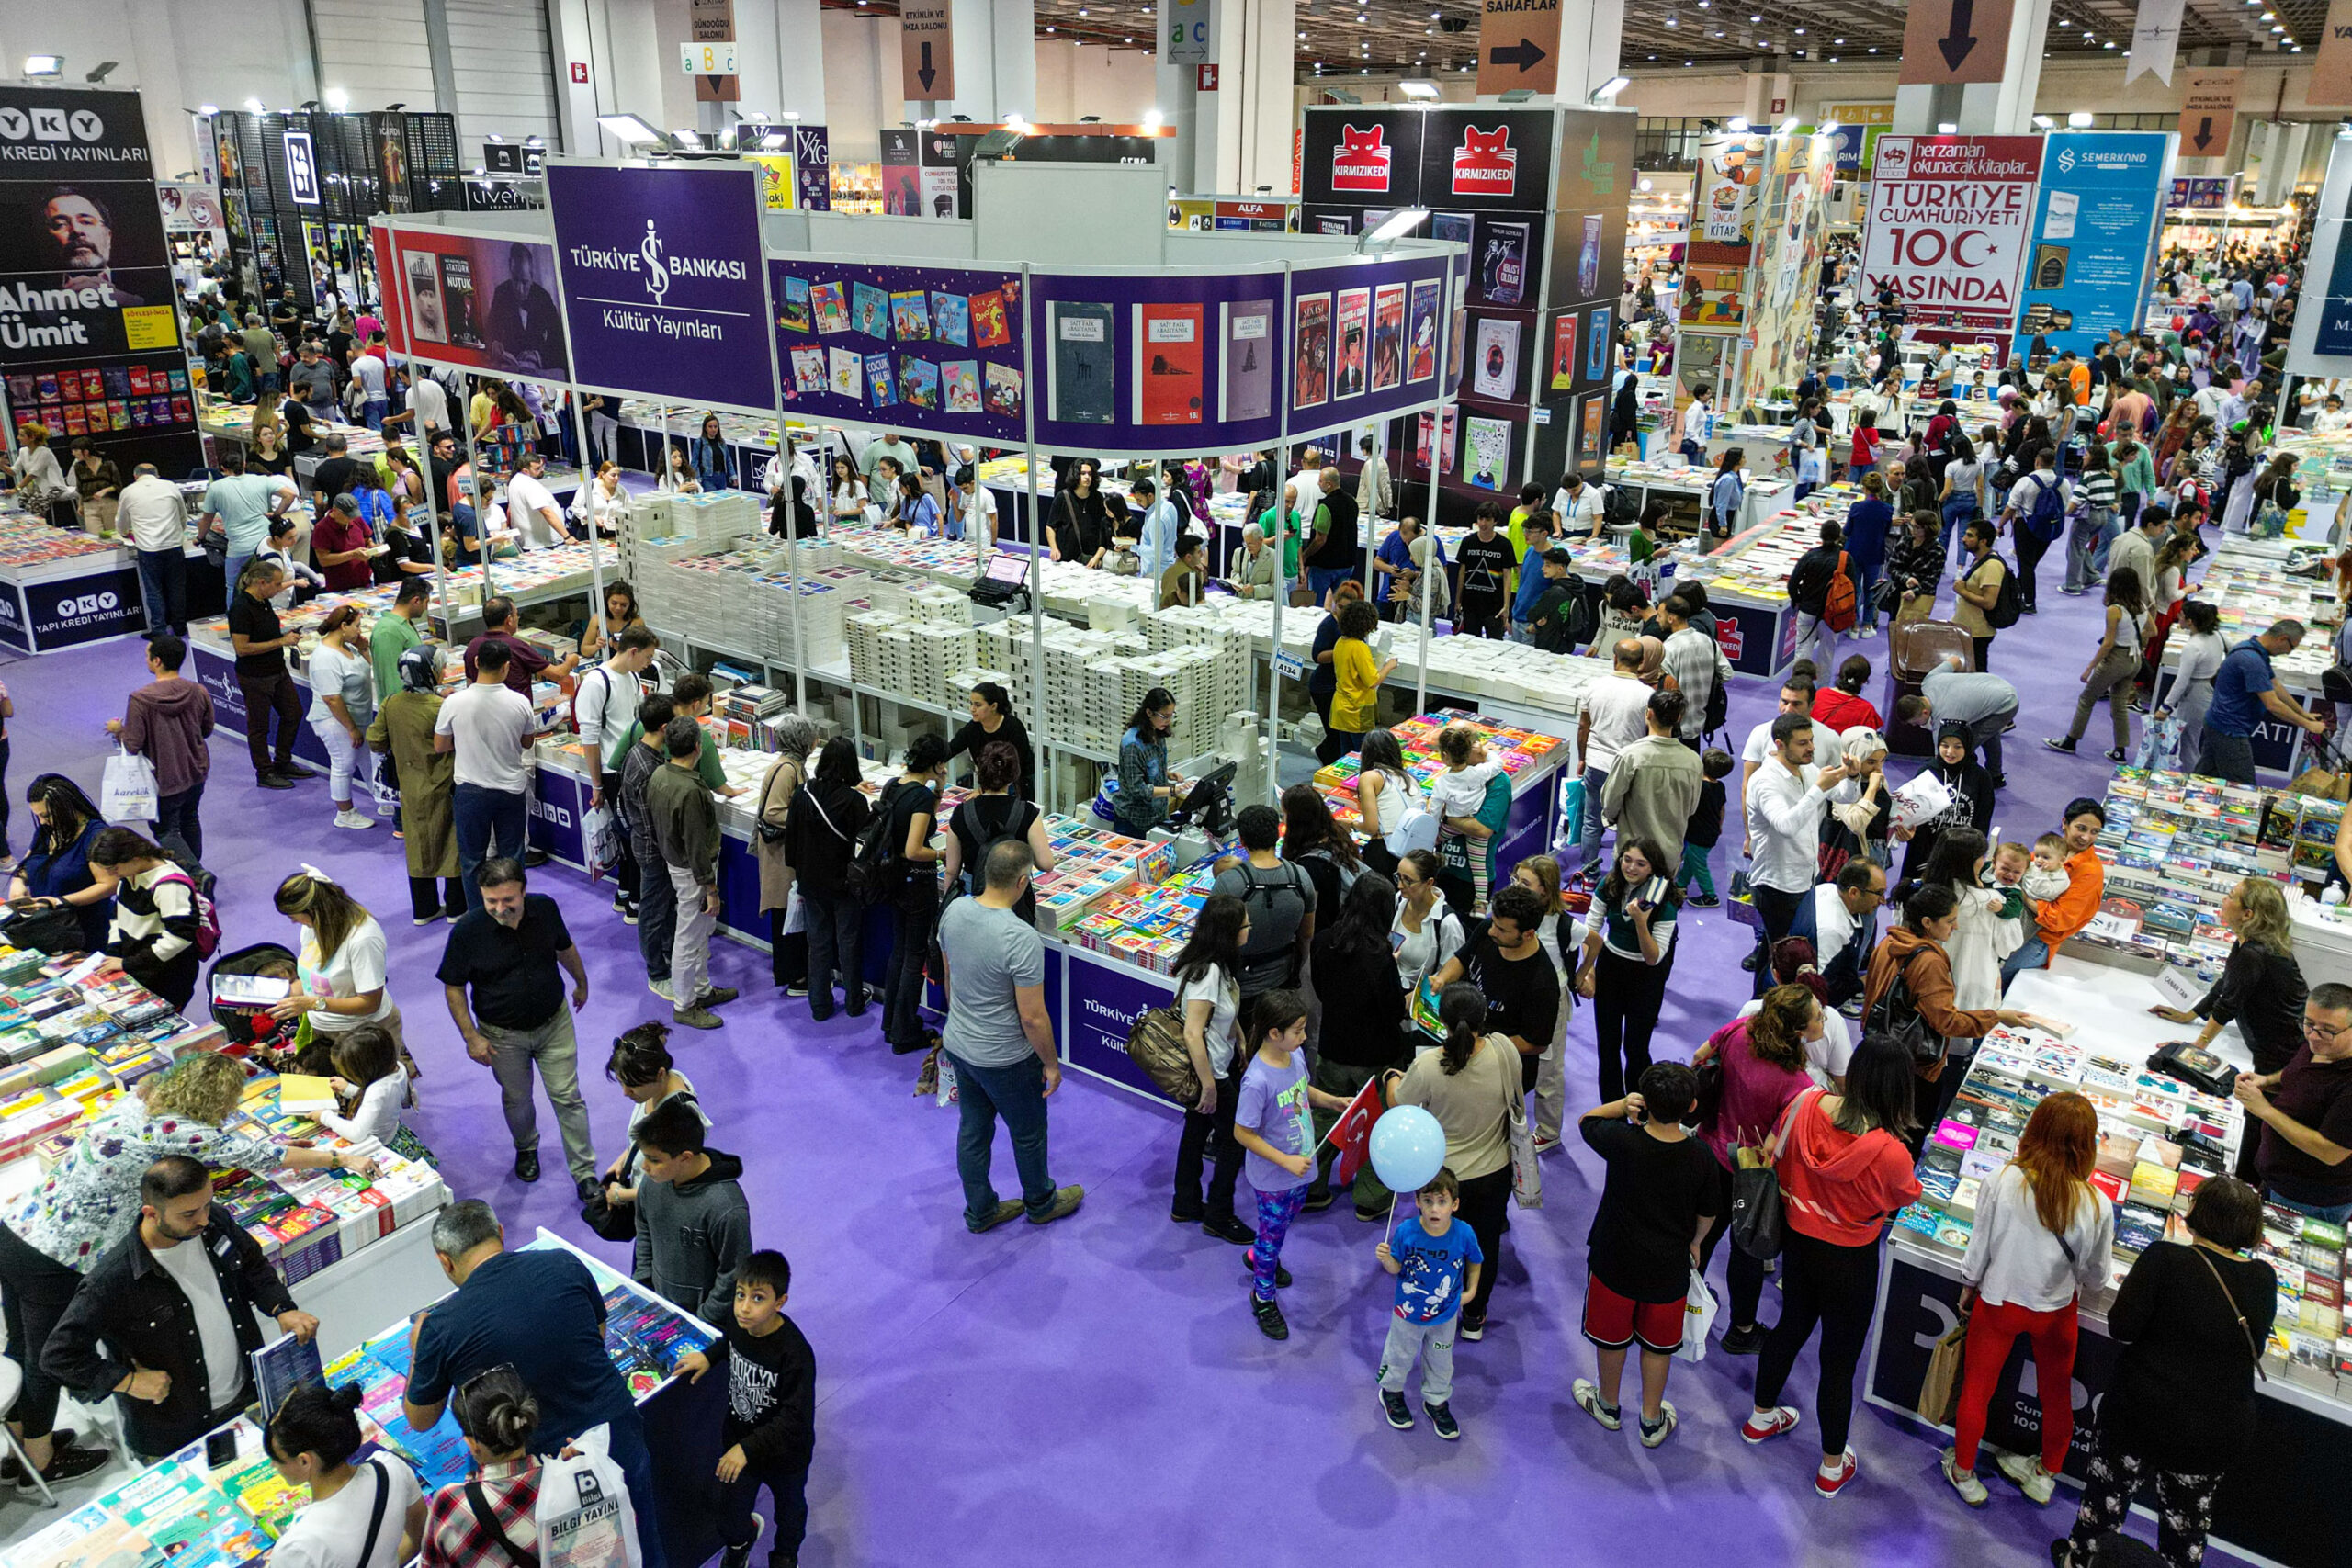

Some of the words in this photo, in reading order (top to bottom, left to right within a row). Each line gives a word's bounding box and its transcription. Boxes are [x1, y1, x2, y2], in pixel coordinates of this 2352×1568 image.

[906, 8, 934, 19] ETKİNLİK
[935, 10, 944, 18] VE
[694, 18, 729, 28] GÜNDOĞDU
[921, 22, 947, 31] SALONU
[699, 30, 724, 39] SALONU
[1171, 23, 1184, 43] a
[684, 58, 693, 71] a
[704, 47, 715, 71] B
[1, 143, 58, 161] KREDİ
[60, 146, 149, 162] YAYINLARI
[1334, 163, 1389, 177] KIRMIZIKEDİ
[1454, 166, 1514, 181] KIRMIZIKEDİ
[1882, 182, 2023, 209] TÜRKİYE
[1238, 204, 1264, 213] ALFA
[1712, 211, 1737, 223] SİNCAP
[1879, 208, 2020, 226] CUMHURİYETİ
[1710, 222, 1736, 238] KİTAP
[570, 244, 641, 272] TÜRKİYE
[669, 256, 747, 281] BANKASI
[447, 276, 472, 289] NUTUK
[1867, 273, 2009, 304] YAŞINDA
[0, 281, 119, 313] Ahmet
[0, 314, 89, 350] Ümit
[603, 309, 650, 333] Kültür
[651, 313, 723, 341] Yayınları
[1481, 550, 1502, 559] FLOYD
[60, 593, 115, 616] YKY
[36, 622, 61, 635] YAPI
[60, 615, 92, 630] KREDİ
[91, 604, 143, 623] YAYINLARI
[1278, 663, 1296, 676] A134
[2164, 976, 2178, 991] CANAN
[2177, 987, 2188, 1000] TAN
[1083, 998, 1135, 1026] TÜRKİYE
[2012, 1414, 2039, 1432] 100
[581, 1495, 602, 1506] Bilgi
[551, 1517, 582, 1537] BİLGİ
